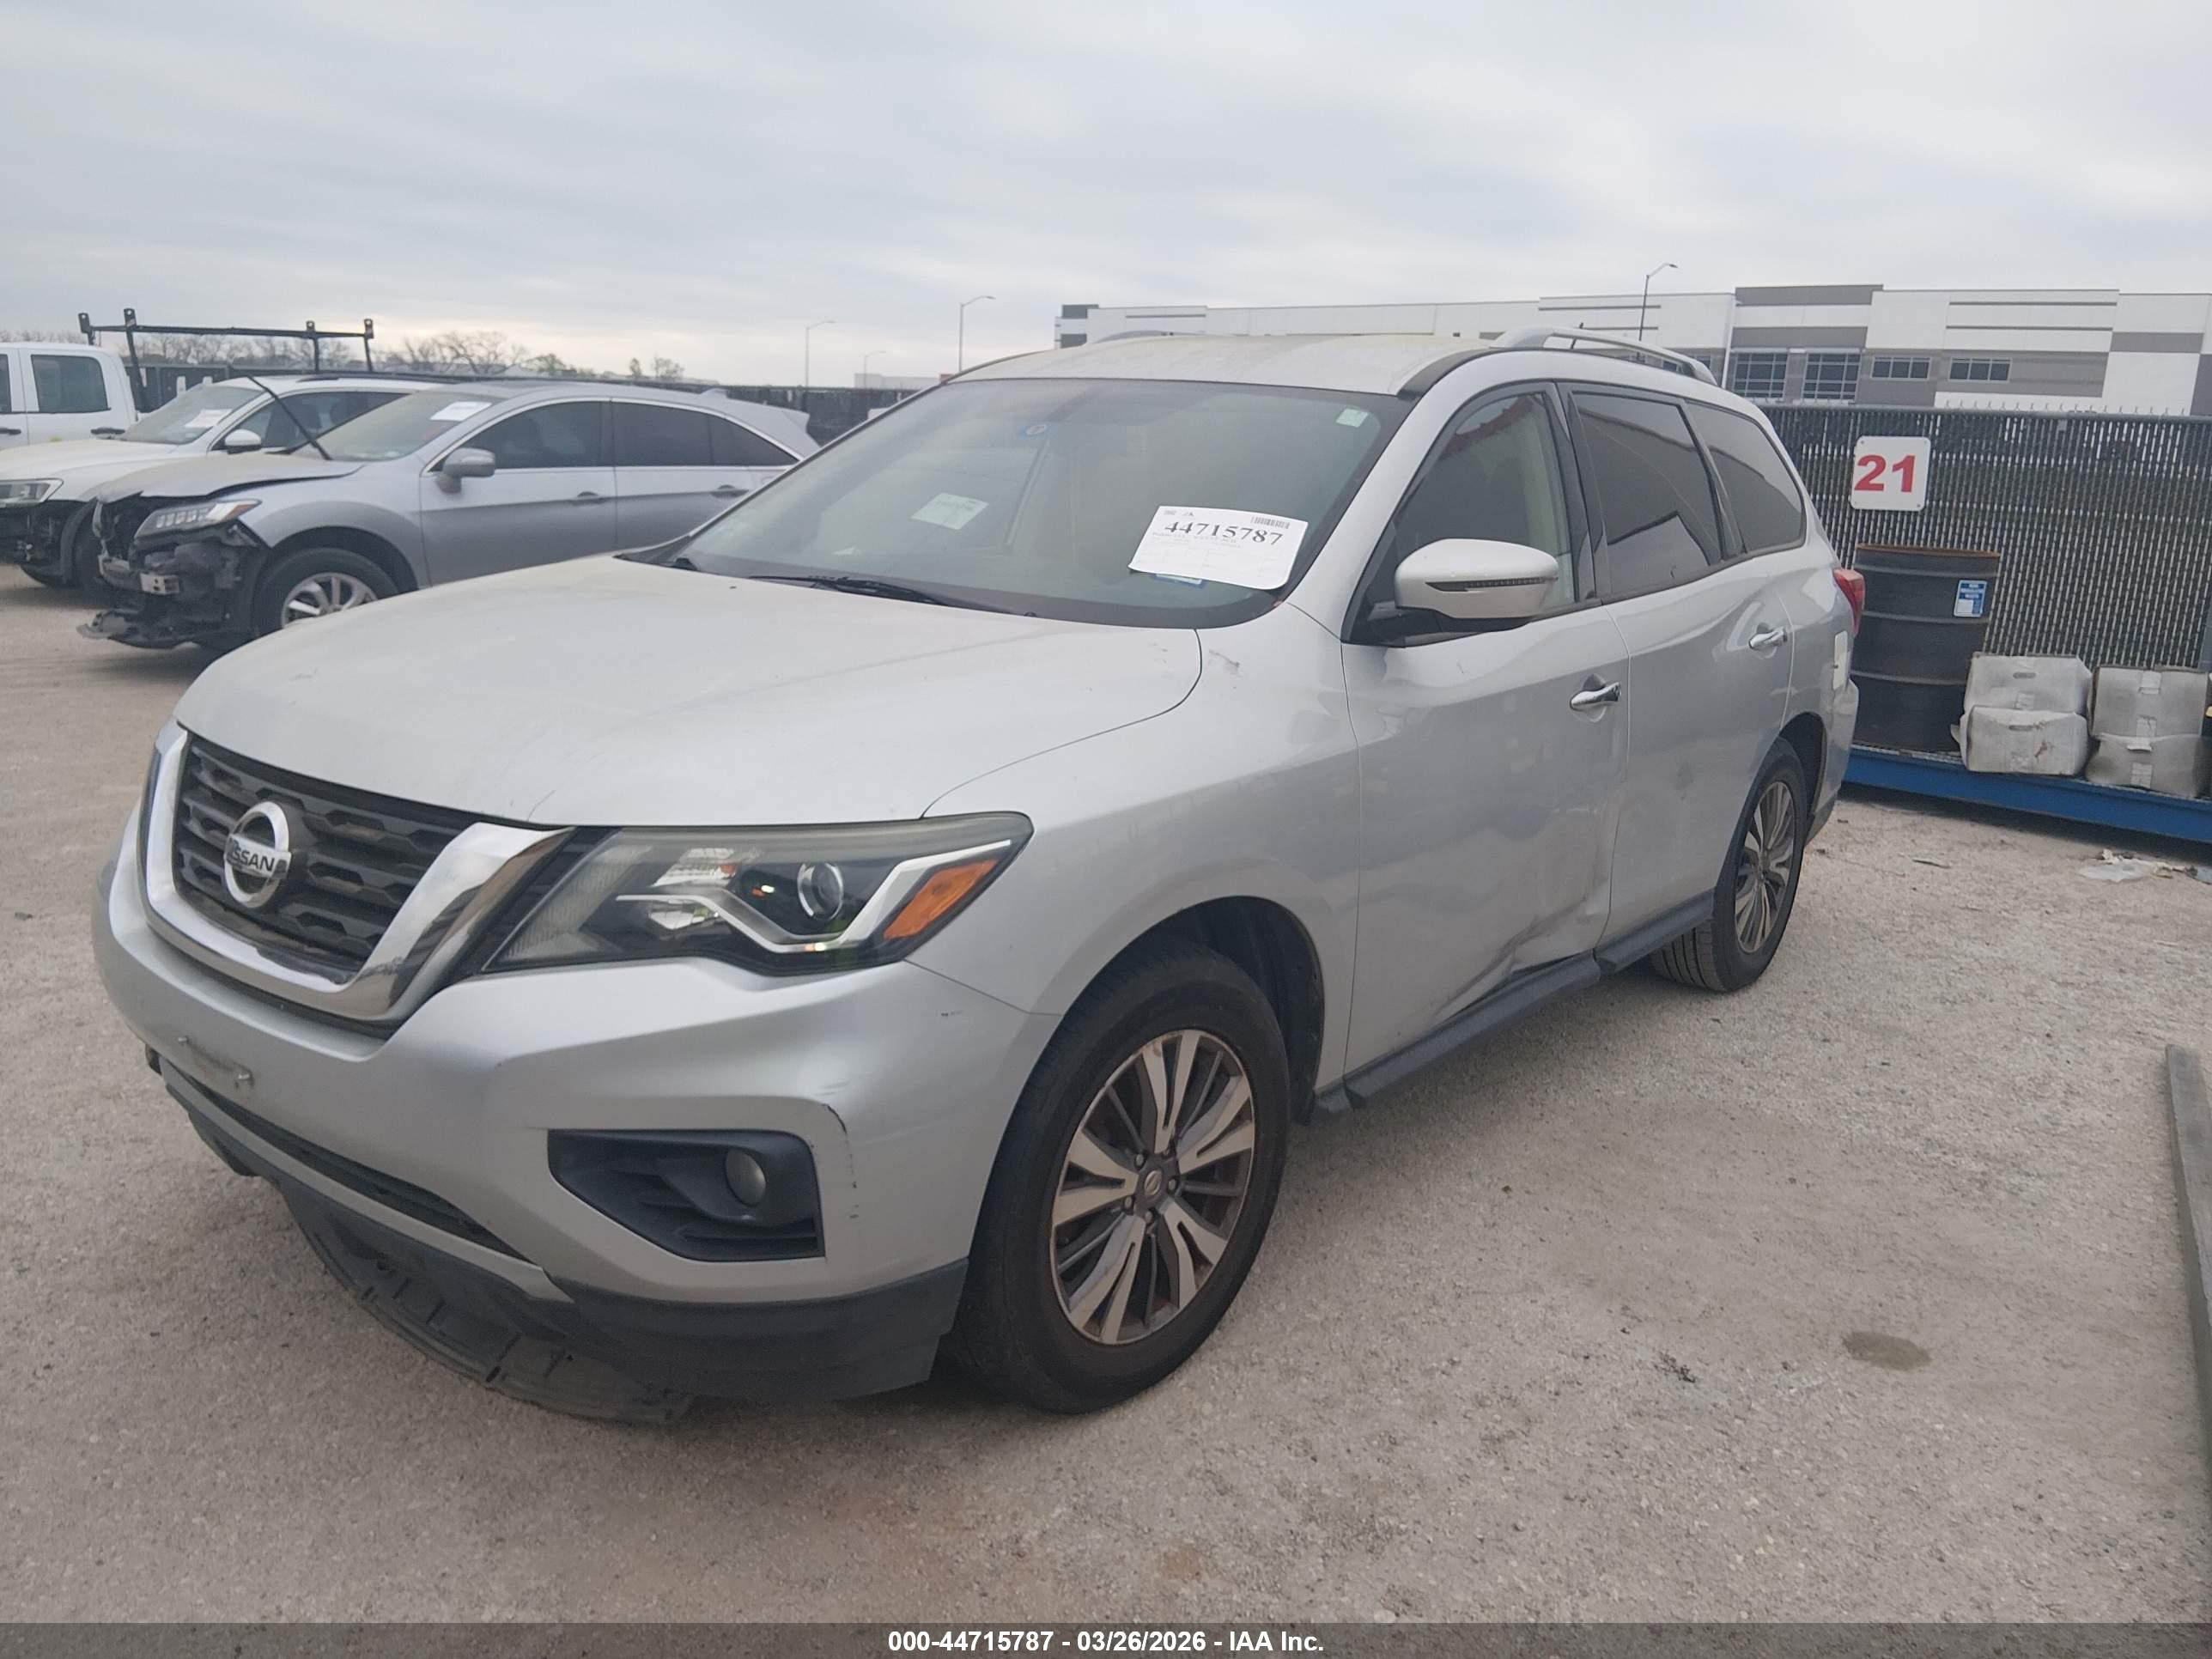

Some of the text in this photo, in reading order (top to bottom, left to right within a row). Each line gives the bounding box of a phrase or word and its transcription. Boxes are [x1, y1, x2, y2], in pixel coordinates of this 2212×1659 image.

[1854, 454, 1916, 492] 21
[1164, 521, 1284, 545] 44715787
[226, 838, 276, 872] SSAN
